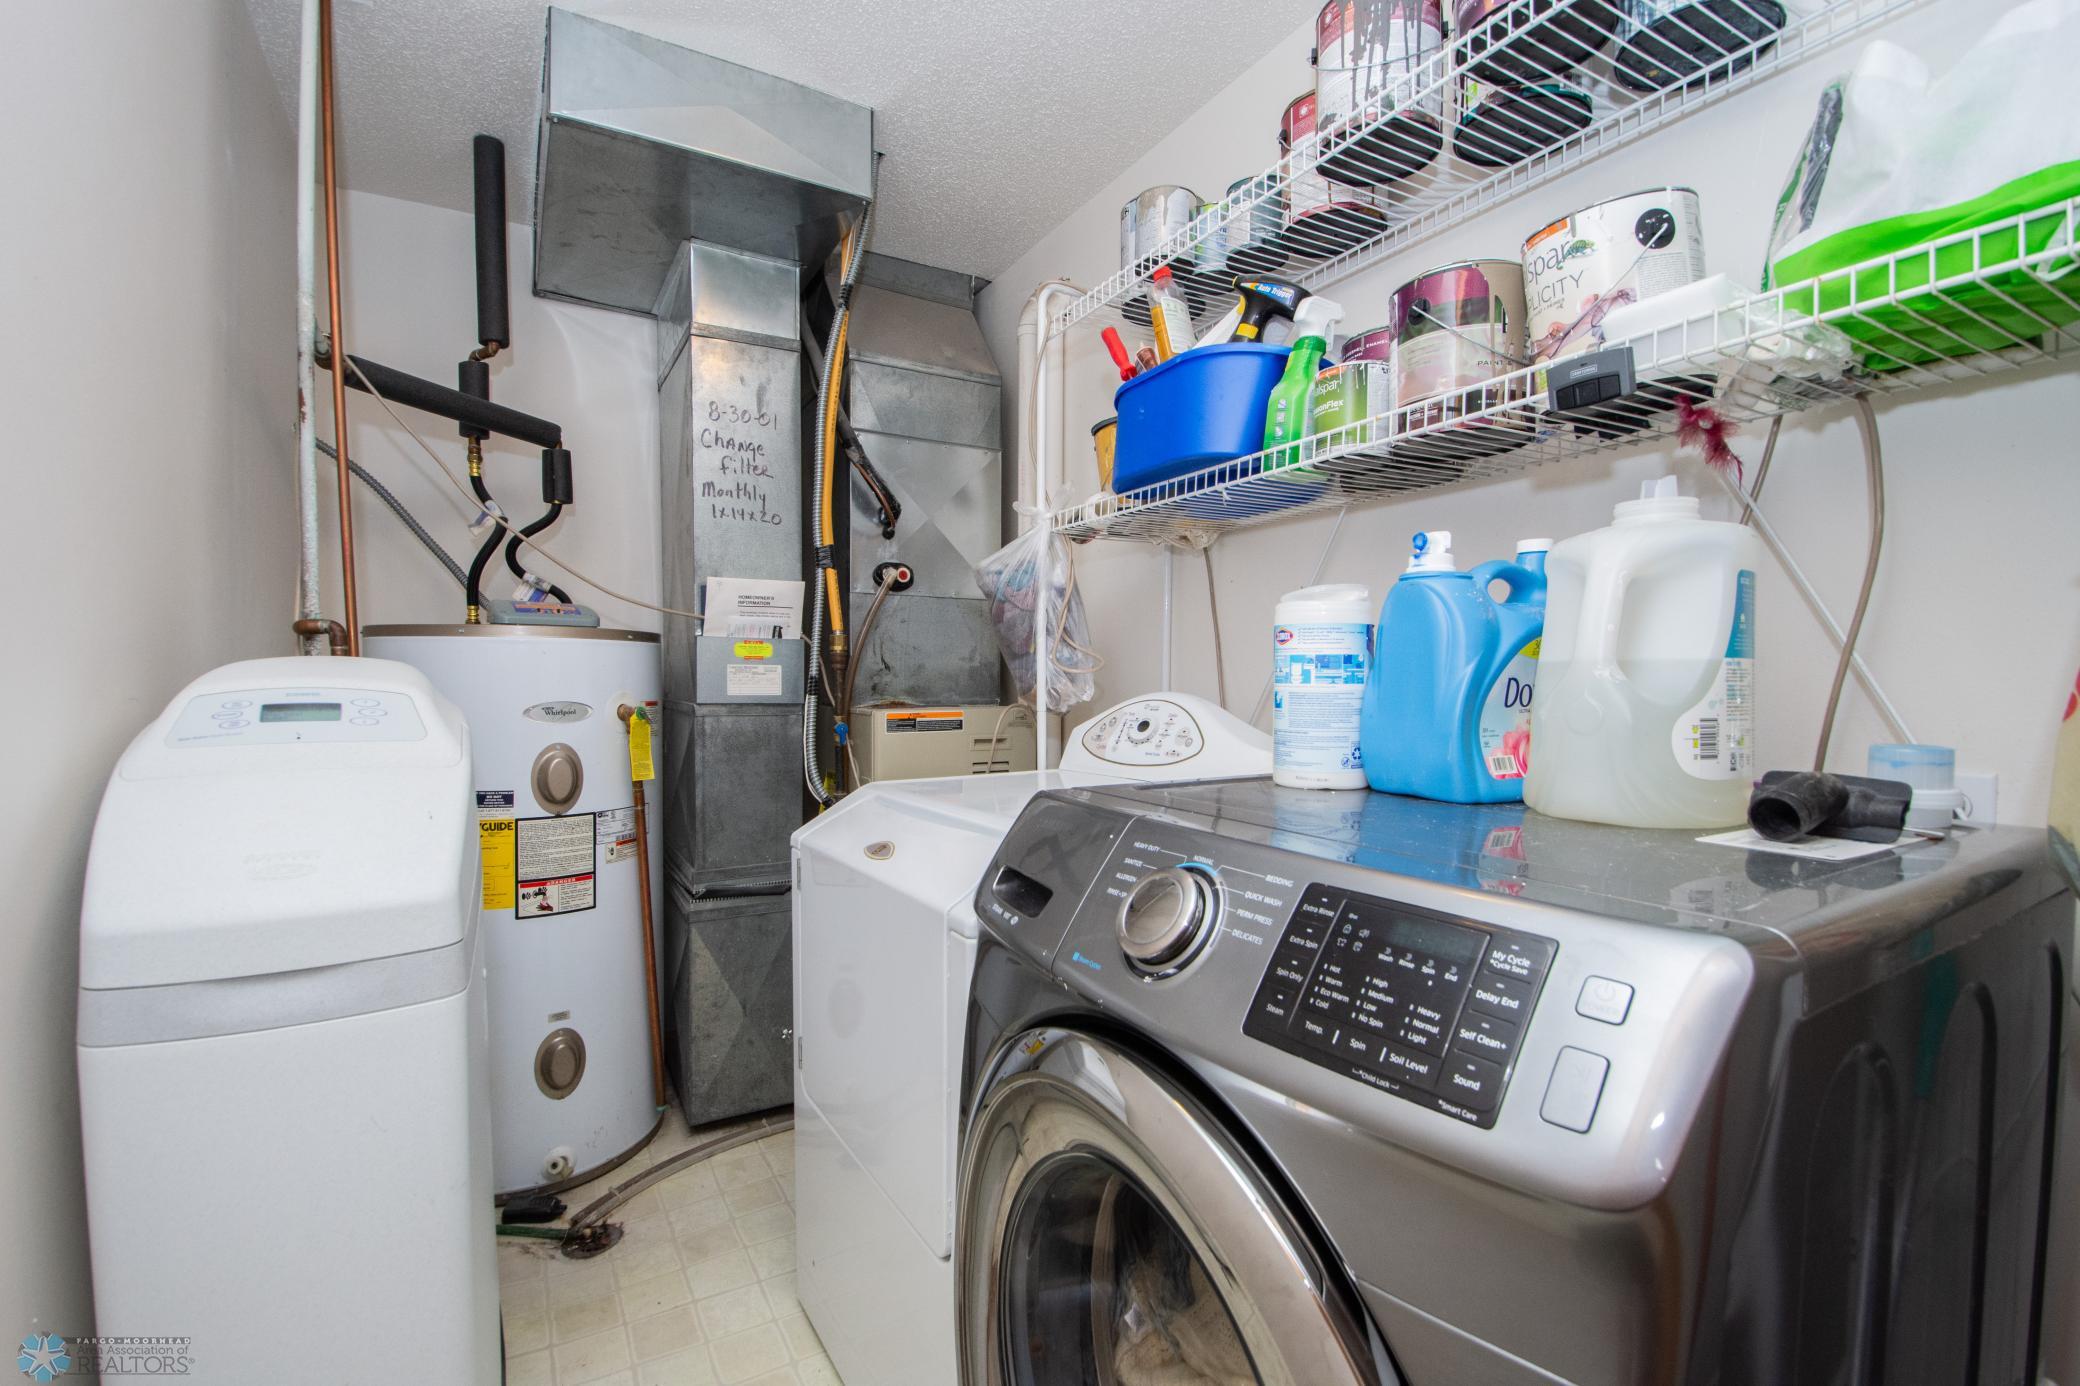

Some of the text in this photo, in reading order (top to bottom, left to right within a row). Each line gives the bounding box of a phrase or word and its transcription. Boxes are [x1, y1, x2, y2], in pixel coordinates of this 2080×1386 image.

[1528, 241, 1570, 285] spar
[1271, 287, 1292, 298] Trigger
[709, 401, 777, 430] 8-30-01
[702, 481, 766, 511] Monthly
[1504, 677, 1533, 708] Do
[480, 822, 513, 832] GUIDE
[1265, 874, 1294, 887] BEDDING
[1244, 891, 1282, 907] QUICK WASH
[1303, 903, 1335, 917] Extra Rinse
[1236, 908, 1273, 926] PERM PRESS
[1232, 928, 1263, 945] DELICATES
[1290, 935, 1319, 949] Extra Spin
[1378, 953, 1393, 962] Wash
[1398, 959, 1415, 969] Rinse
[1492, 950, 1531, 967] My Cycle
[1276, 967, 1303, 982] Spin Only
[1329, 965, 1342, 974] Hot
[1421, 965, 1435, 975] Spin
[1511, 965, 1528, 975] Save
[1325, 976, 1343, 987] Warm
[1372, 977, 1388, 988] High
[1444, 972, 1458, 982] End
[1320, 987, 1350, 1003] Eco Warm
[1368, 989, 1394, 1004] Medium
[1475, 990, 1520, 1009] Delay End
[1266, 1003, 1284, 1016] Steam
[1315, 999, 1330, 1009] Cold
[1363, 1001, 1378, 1012] Low
[1417, 1005, 1441, 1021] Heavy
[1358, 1013, 1383, 1029] No Spin
[1412, 1019, 1440, 1034] Normal
[1407, 1032, 1427, 1045] Light
[1459, 1028, 1477, 1041] Self
[1350, 1038, 1366, 1051] Spin
[1389, 1052, 1428, 1074] Soil Level
[1376, 1077, 1390, 1088] Lock
[1453, 1073, 1481, 1092] Sound
[1461, 1109, 1478, 1122] Care
